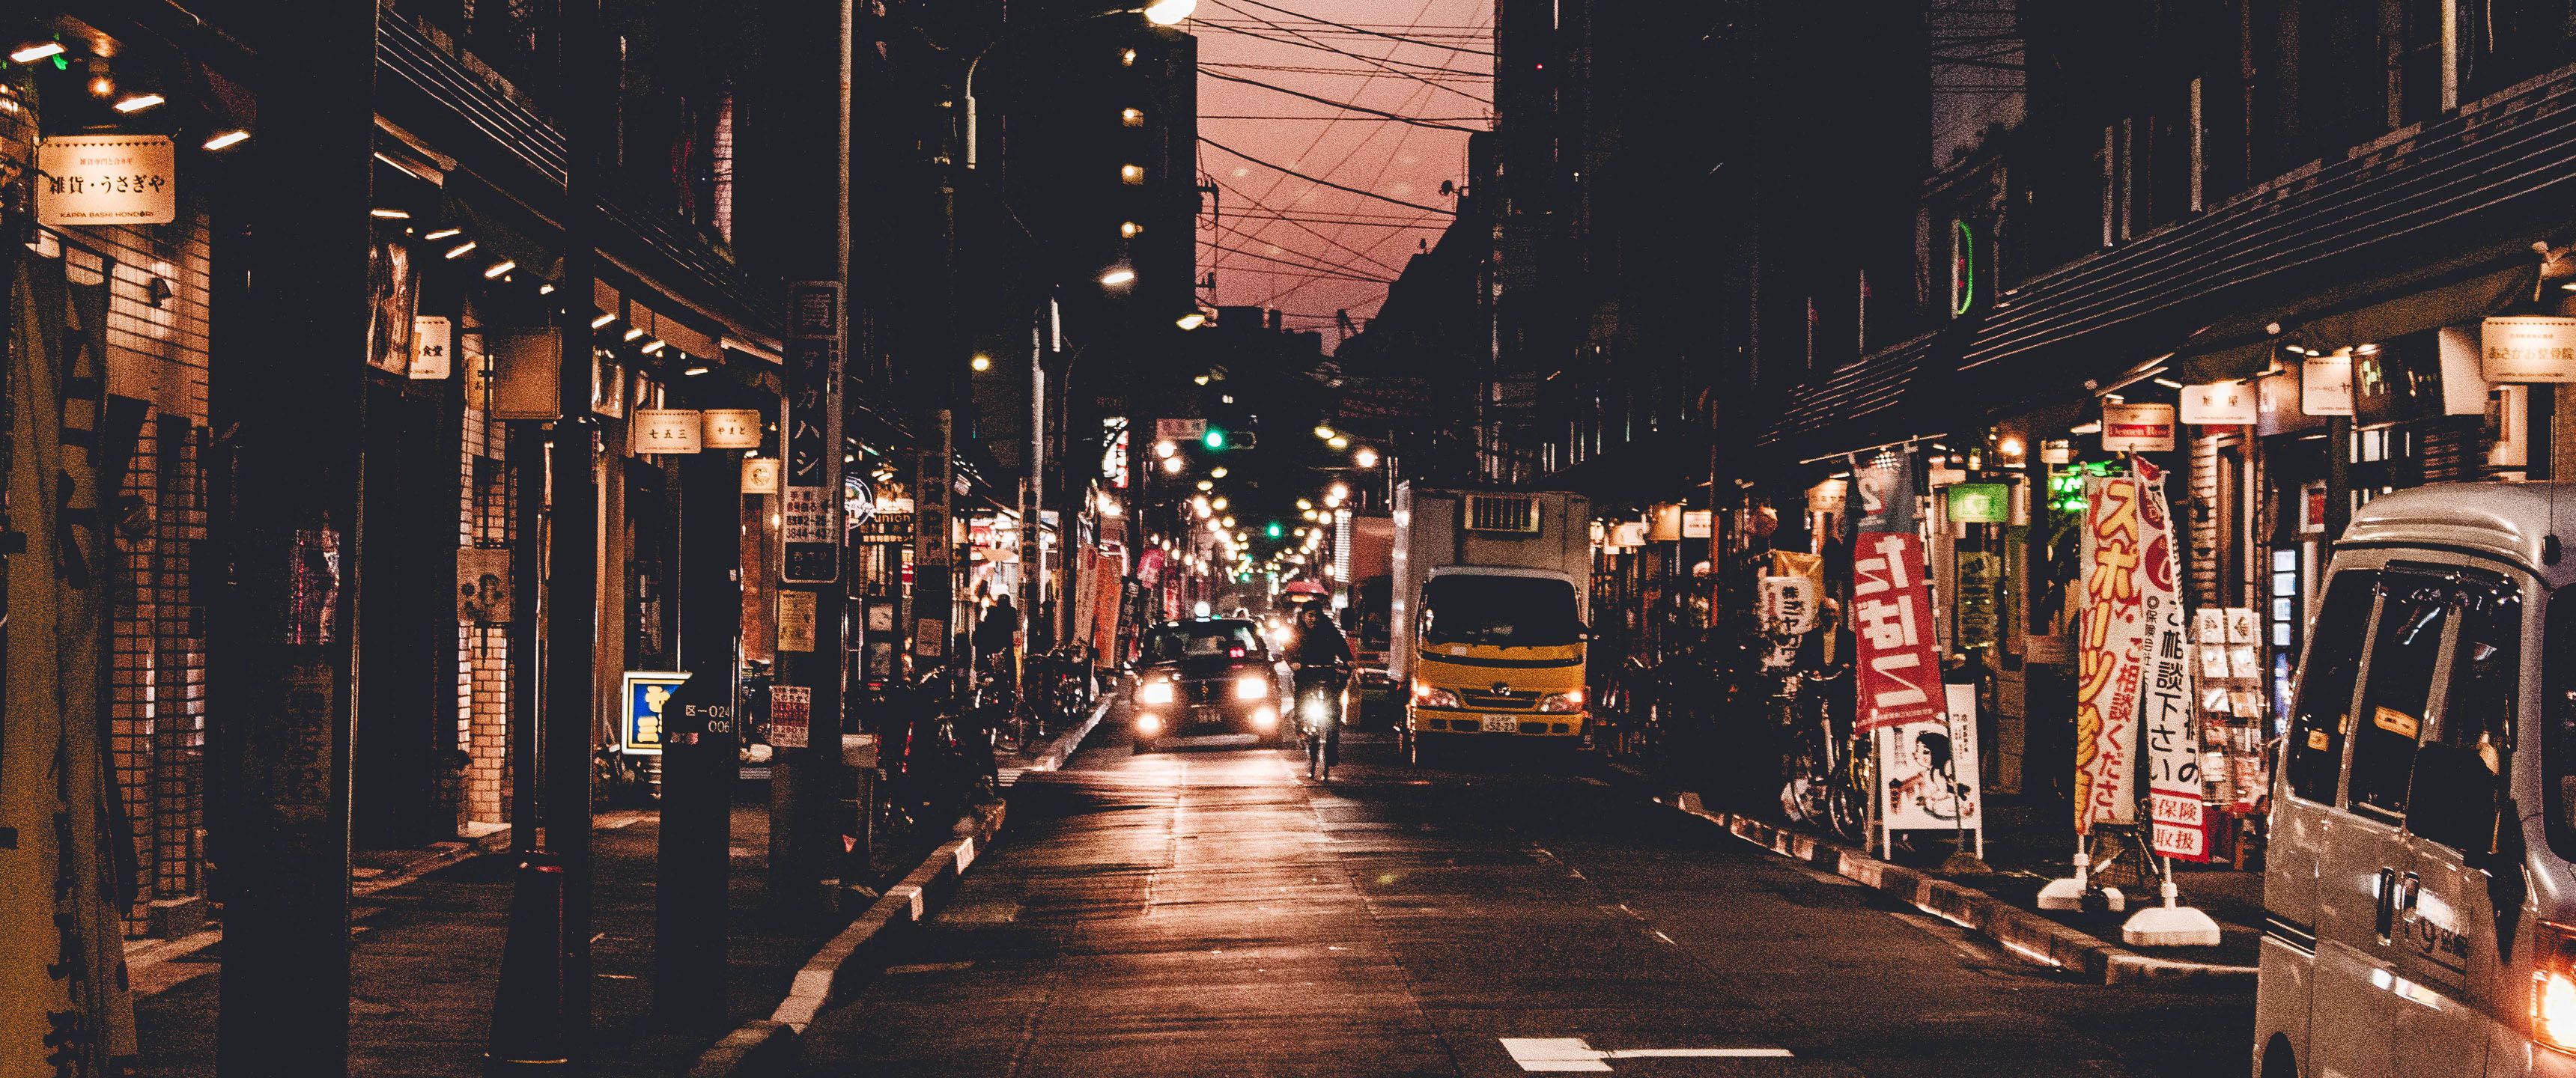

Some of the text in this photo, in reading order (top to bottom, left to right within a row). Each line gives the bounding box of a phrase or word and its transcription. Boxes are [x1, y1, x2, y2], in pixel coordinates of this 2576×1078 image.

[49, 174, 165, 195] 雑貨・うさぎや
[419, 345, 443, 357] 食堂
[648, 428, 687, 439] 七五三
[717, 426, 746, 436] やまと
[708, 720, 729, 733] 006
[2151, 796, 2197, 822] 保険
[2157, 829, 2194, 850] 取扱
